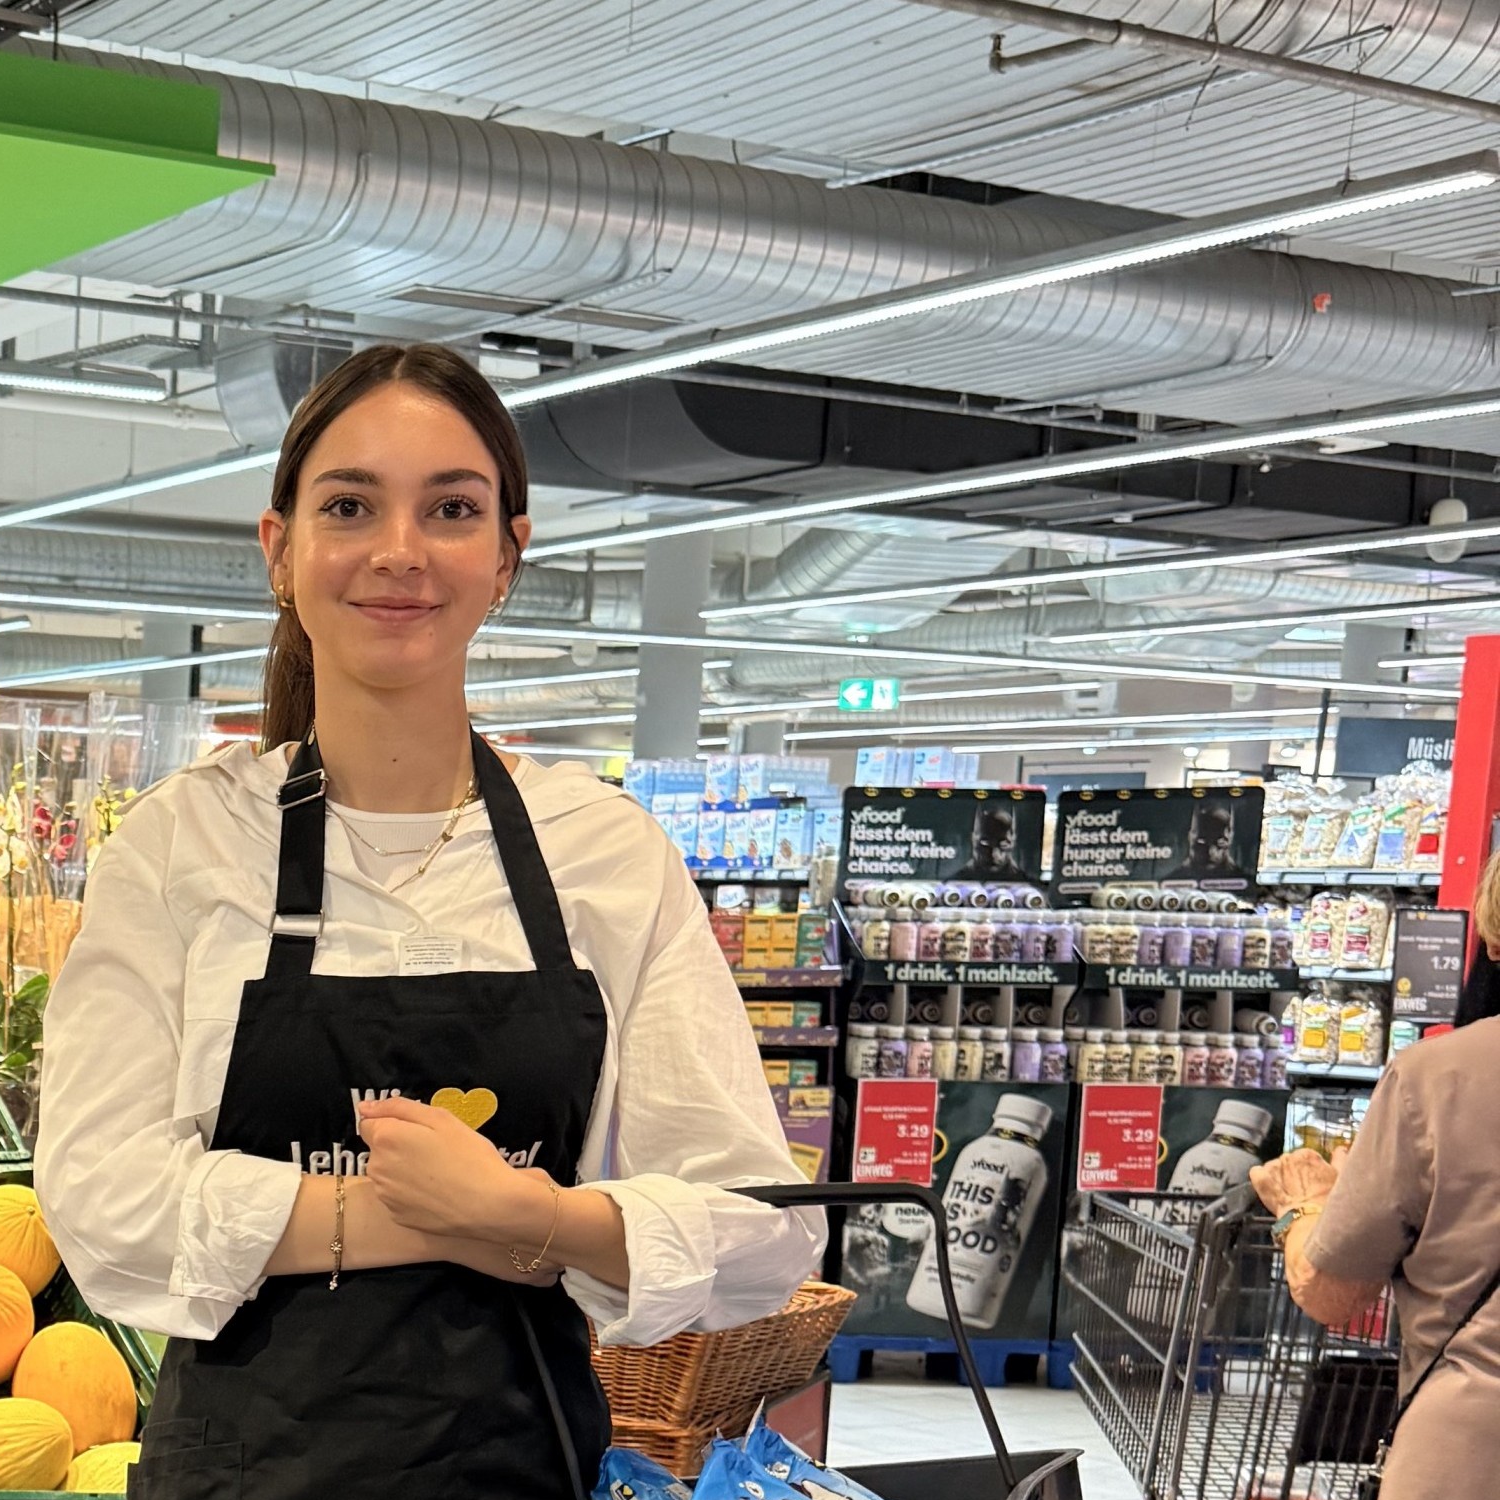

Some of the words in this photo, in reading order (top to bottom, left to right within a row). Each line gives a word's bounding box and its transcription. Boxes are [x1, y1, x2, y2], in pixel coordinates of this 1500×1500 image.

[1406, 736, 1455, 761] Müsli
[850, 806, 904, 825] yfood
[1065, 809, 1119, 829] yfood
[849, 824, 894, 842] lässt
[894, 825, 933, 842] dem
[1064, 828, 1109, 845] lässt
[1109, 827, 1149, 844] dem
[848, 842, 909, 861] hunger
[910, 842, 956, 859] keine
[1063, 844, 1124, 863] hunger
[1125, 843, 1173, 860] keine
[847, 860, 915, 875] chance.
[1062, 862, 1130, 878] chance.
[896, 963, 953, 983] drink.
[968, 964, 1059, 985] mahlzeit.
[1117, 967, 1174, 987] drink.
[1188, 969, 1280, 990] mahlzeit.
[950, 1180, 995, 1205] THIS
[947, 1226, 998, 1254] OOD
